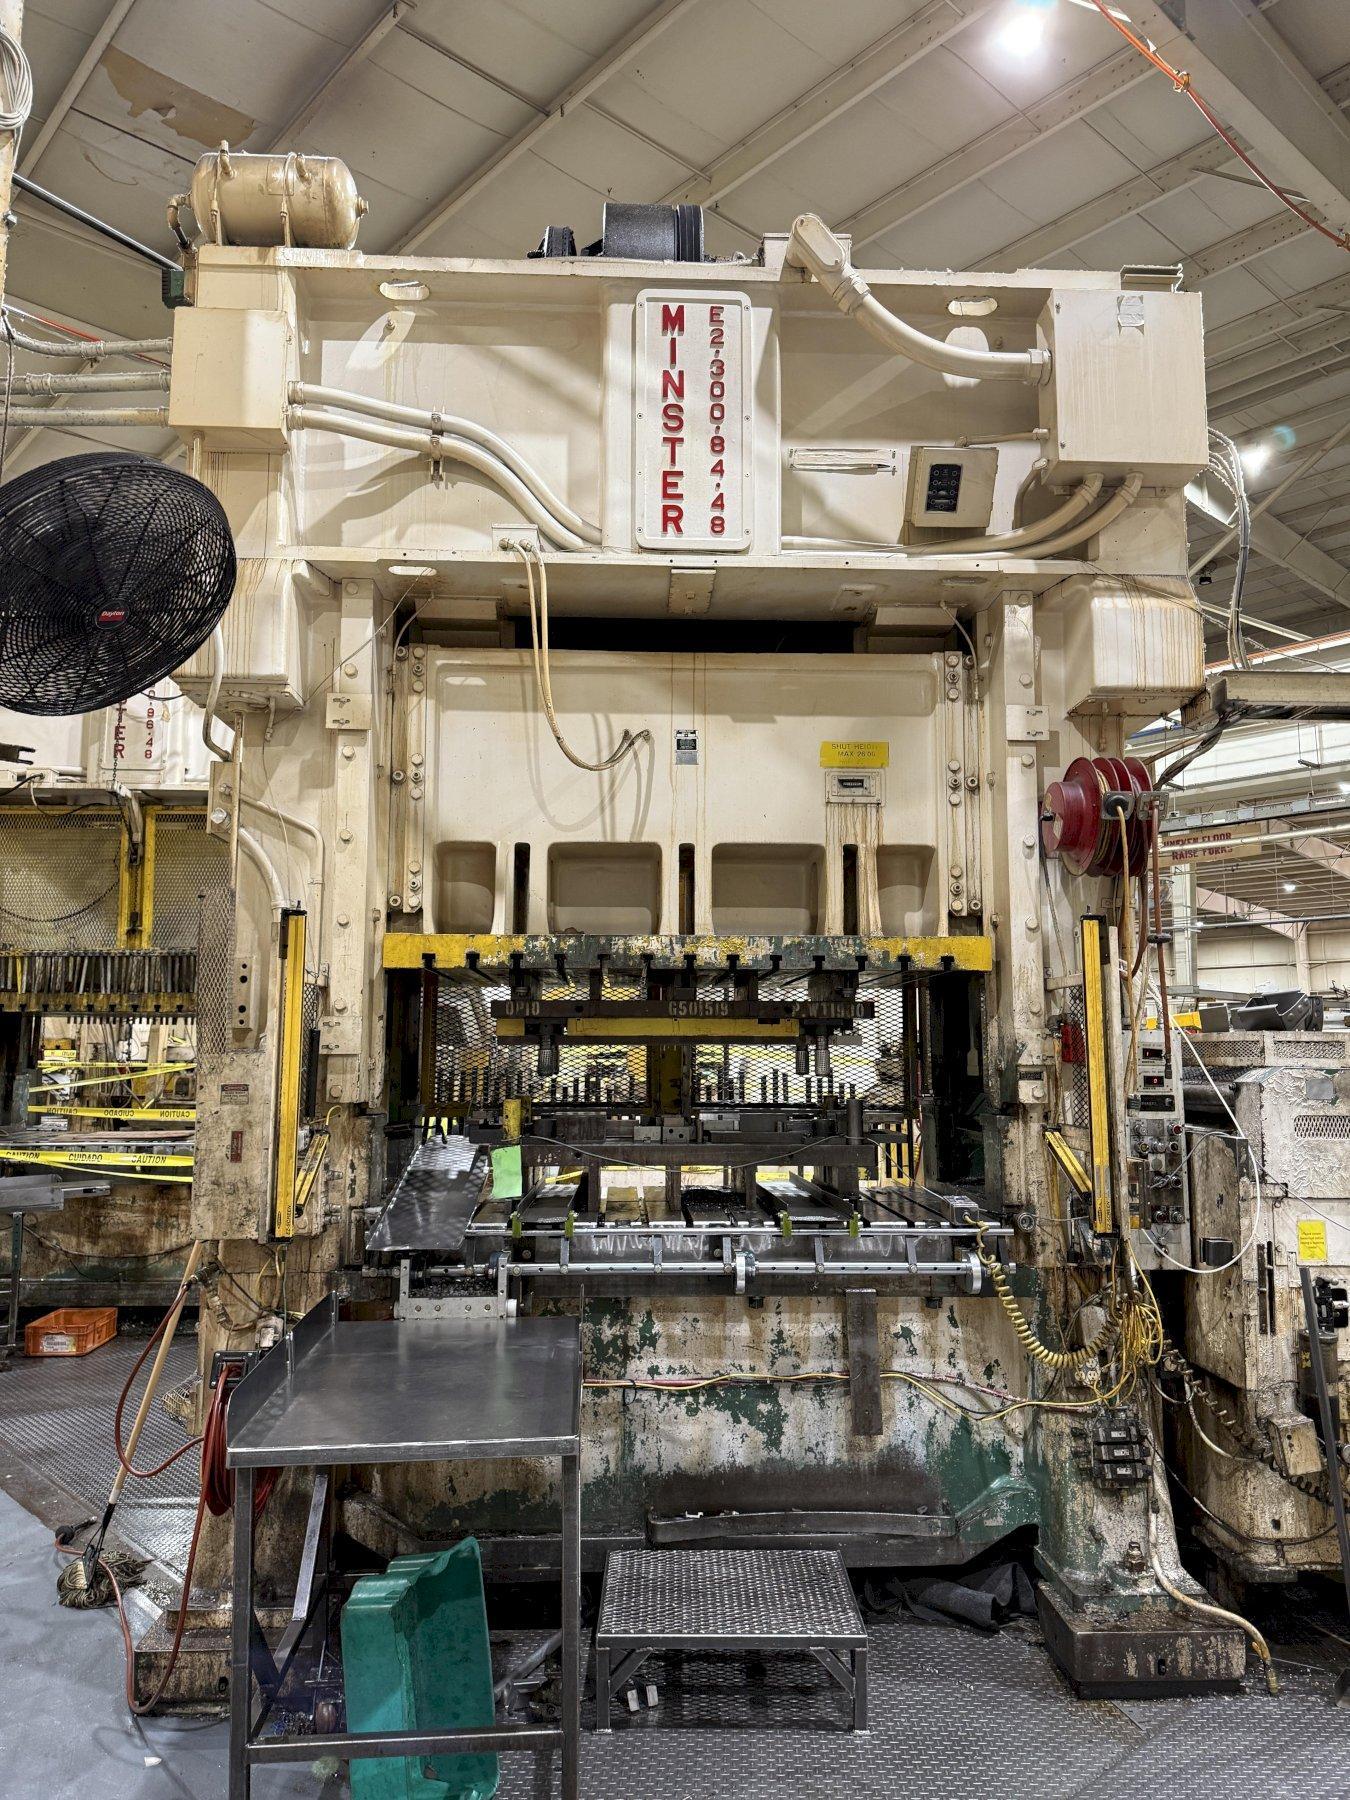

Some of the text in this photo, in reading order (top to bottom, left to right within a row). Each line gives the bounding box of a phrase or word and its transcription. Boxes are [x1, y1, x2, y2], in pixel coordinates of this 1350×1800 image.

[661, 304, 685, 535] MINSTER
[1171, 849, 1198, 861] RAISE
[131, 1155, 167, 1164] CAUTION
